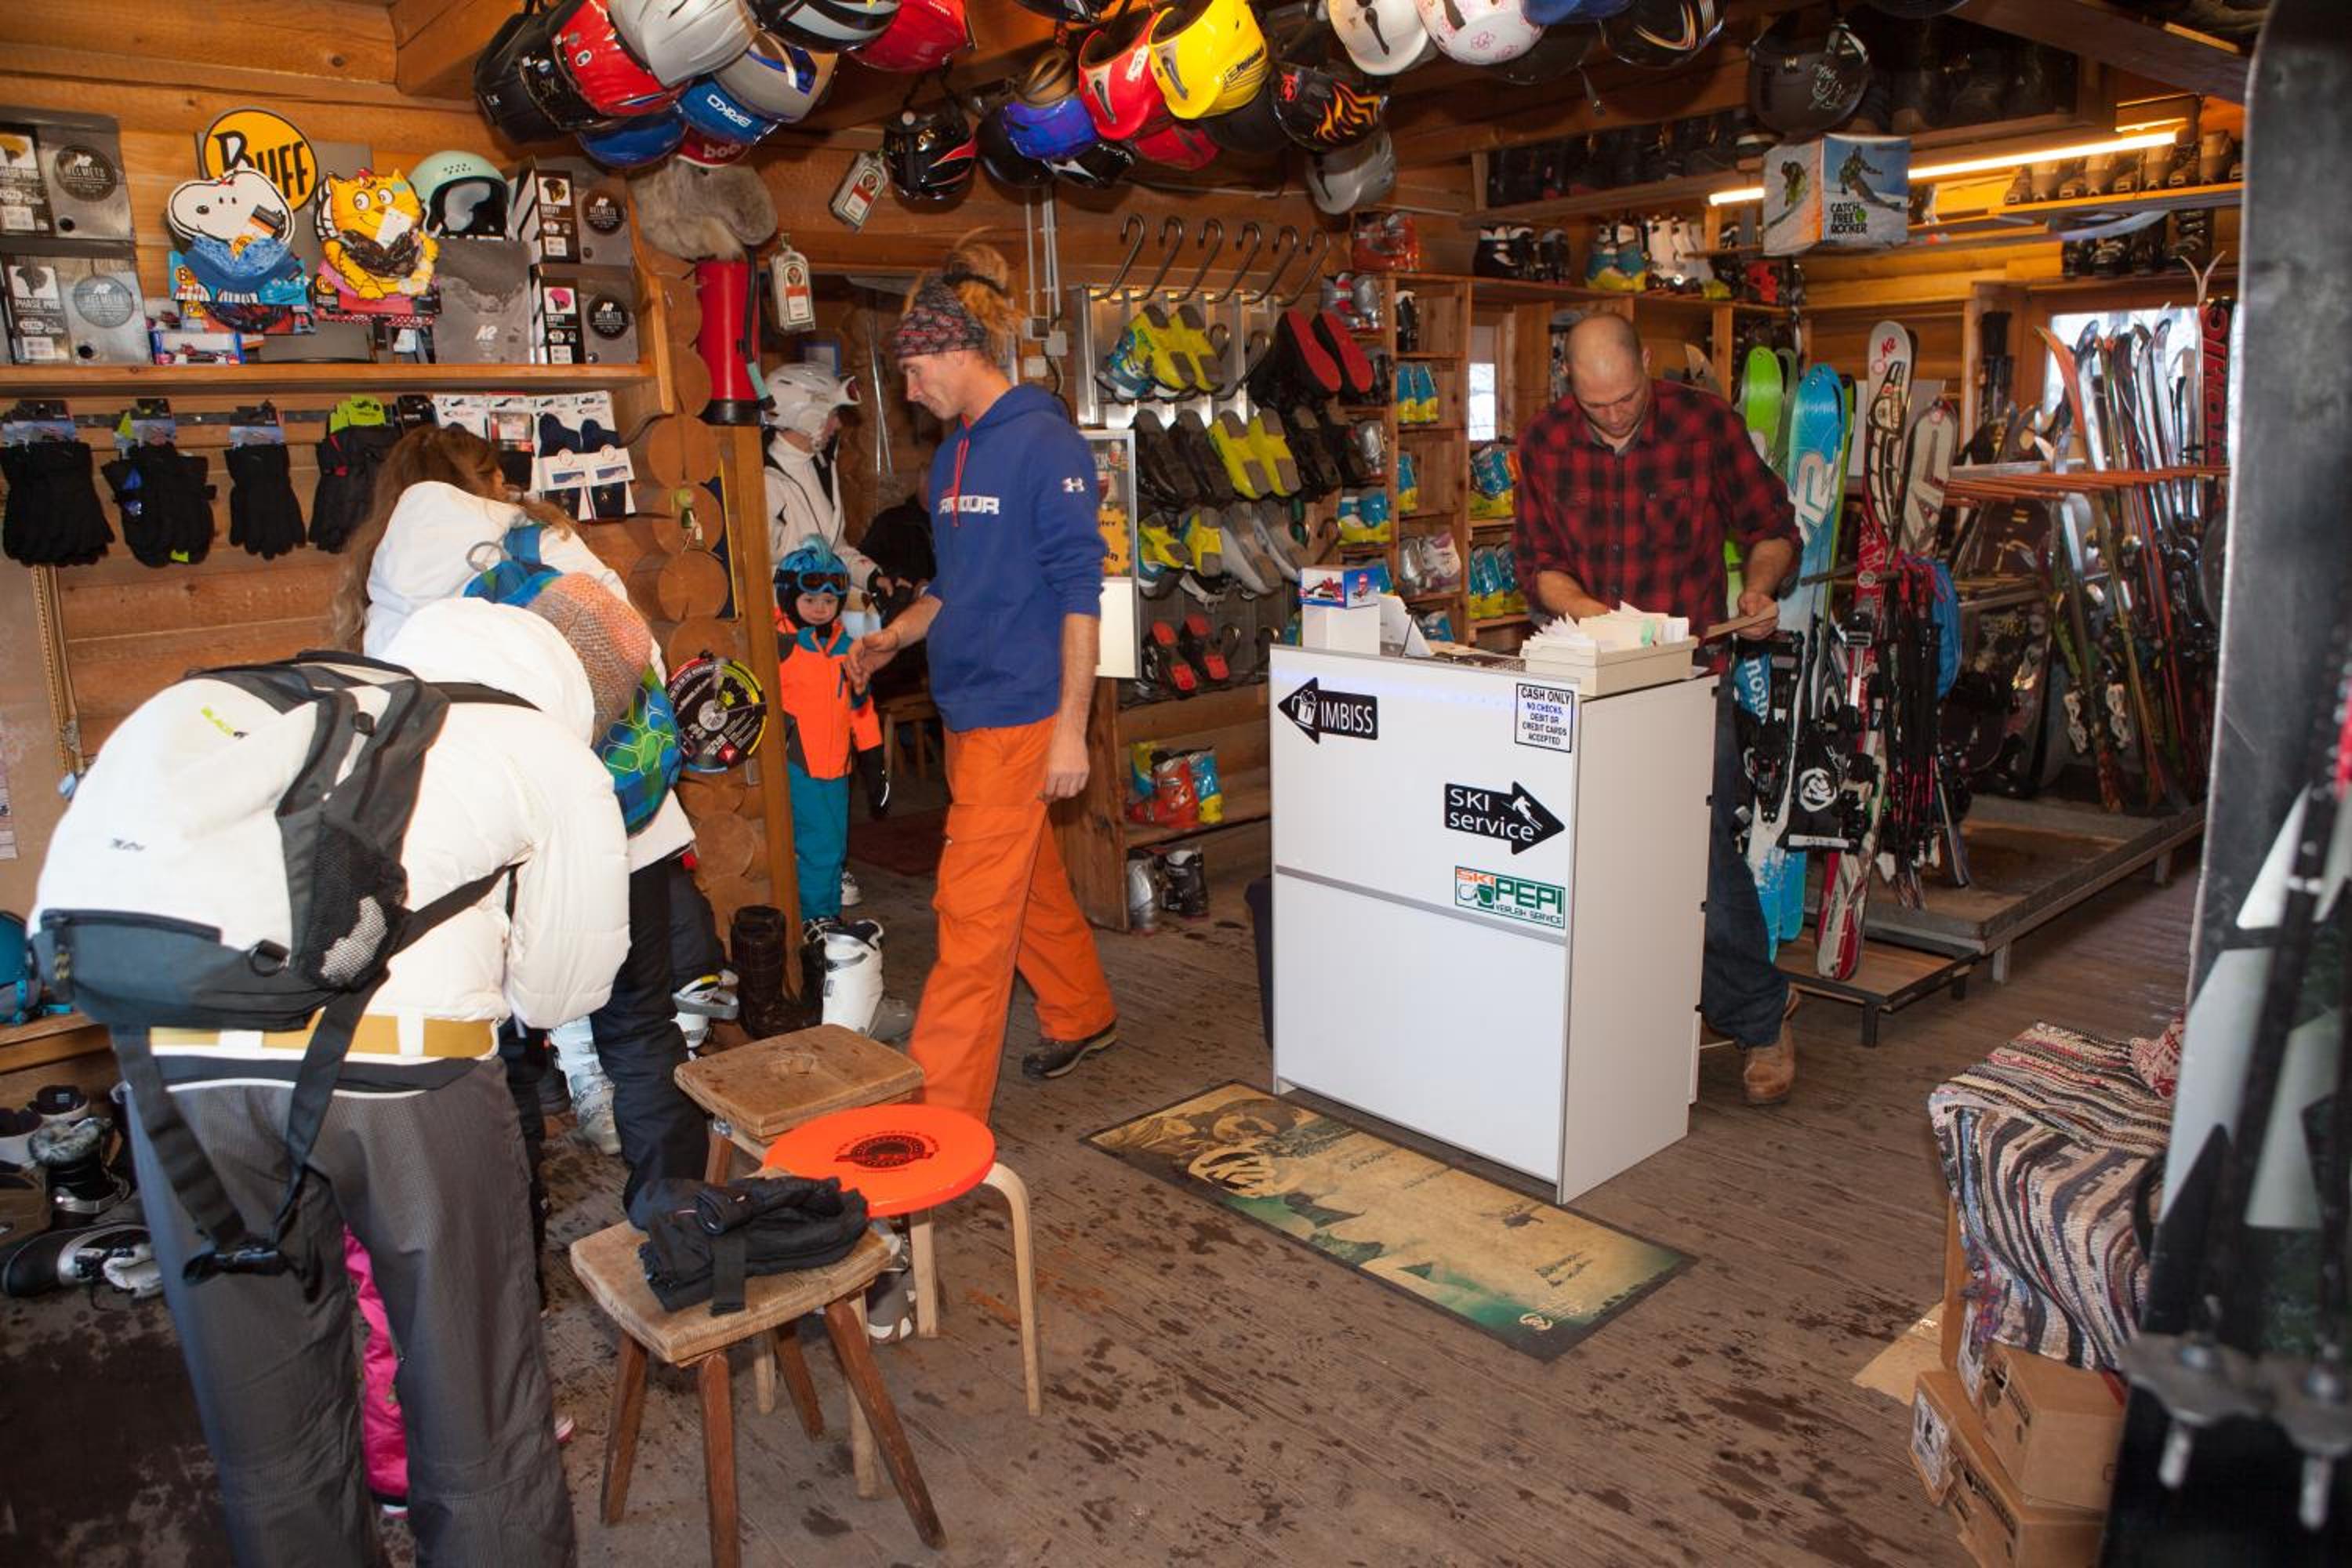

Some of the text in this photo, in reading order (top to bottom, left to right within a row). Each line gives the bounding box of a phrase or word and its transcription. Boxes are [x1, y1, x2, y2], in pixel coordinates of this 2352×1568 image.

[213, 130, 307, 199] BUFF
[1830, 202, 1860, 213] CATCH
[1832, 212, 1855, 223] FREE
[1521, 687, 1570, 705] CASH ONLY
[1526, 702, 1536, 711] NO
[1320, 700, 1374, 735] IMBISS
[1530, 713, 1548, 722] DEBIT
[1522, 721, 1567, 736] CREDIT CARDS
[1528, 732, 1561, 746] ACCEPTED
[1450, 788, 1490, 812] SKI
[1449, 811, 1535, 842] service
[1457, 869, 1563, 915] SKI PEPI
